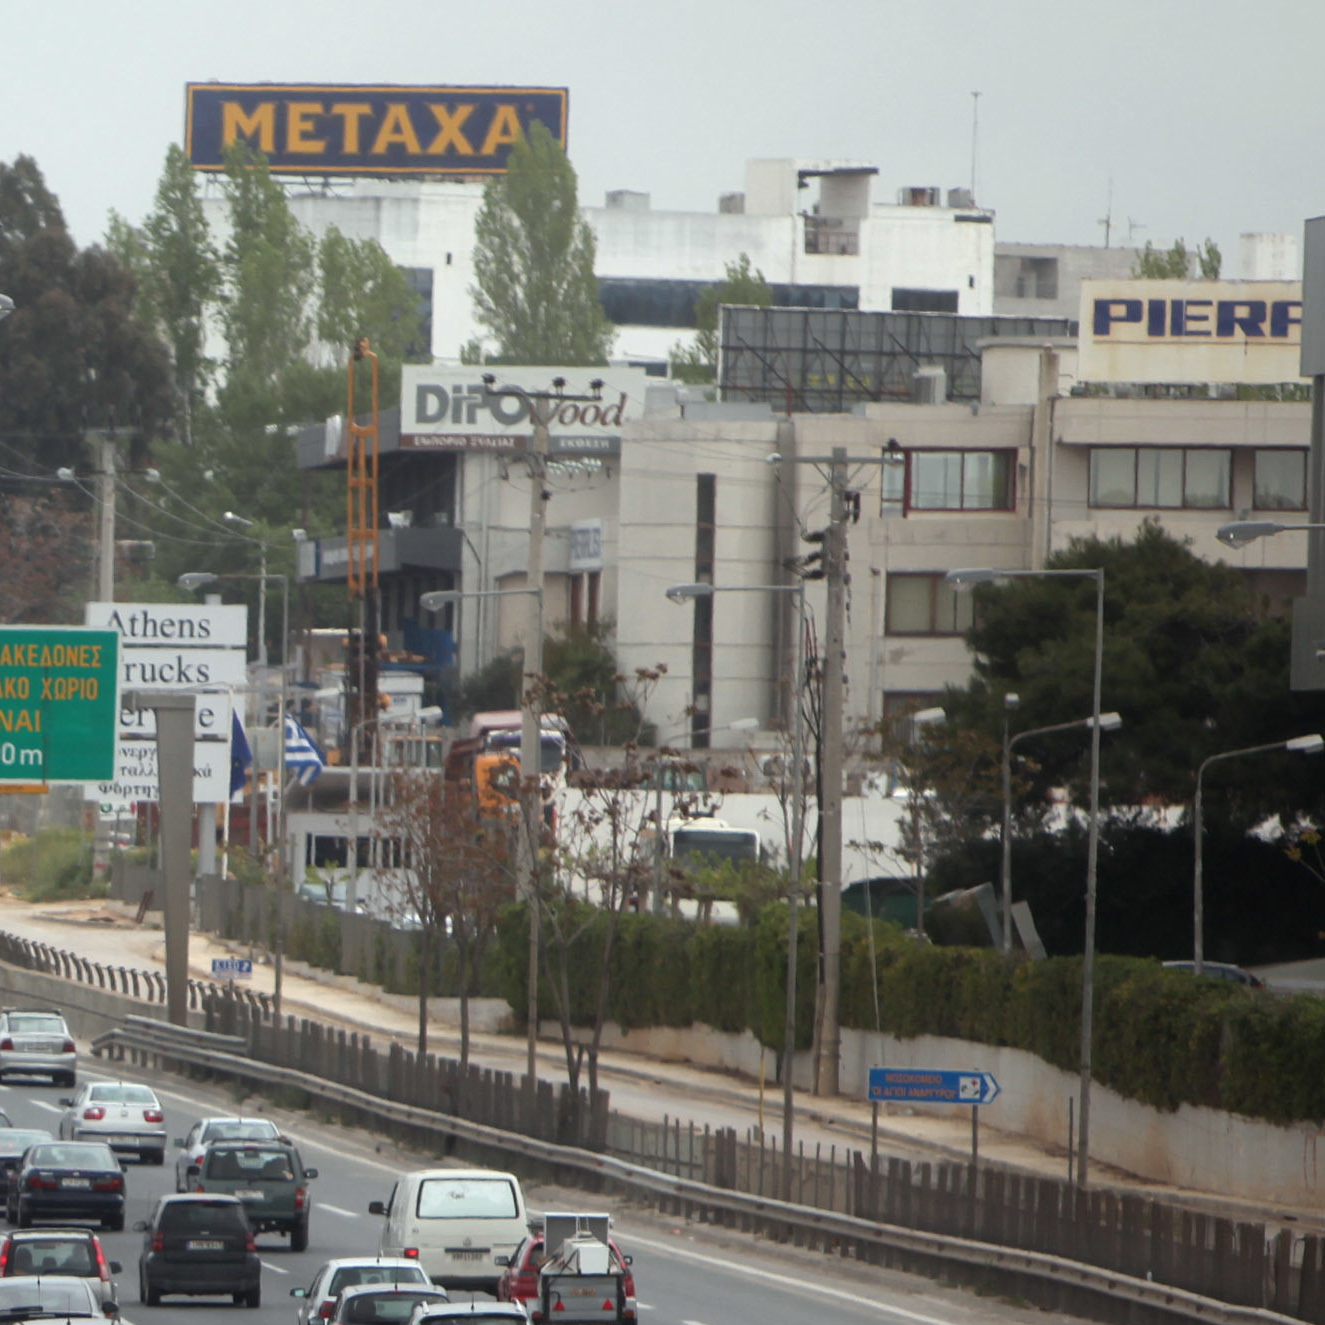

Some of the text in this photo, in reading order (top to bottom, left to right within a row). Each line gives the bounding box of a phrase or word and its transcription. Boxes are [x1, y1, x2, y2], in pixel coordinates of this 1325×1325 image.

[219, 101, 525, 155] METAXA
[108, 610, 211, 638] Athens
[124, 655, 210, 683] rucks
[40, 677, 98, 701] ΧΩΡΙΟ
[20, 748, 43, 765] m
